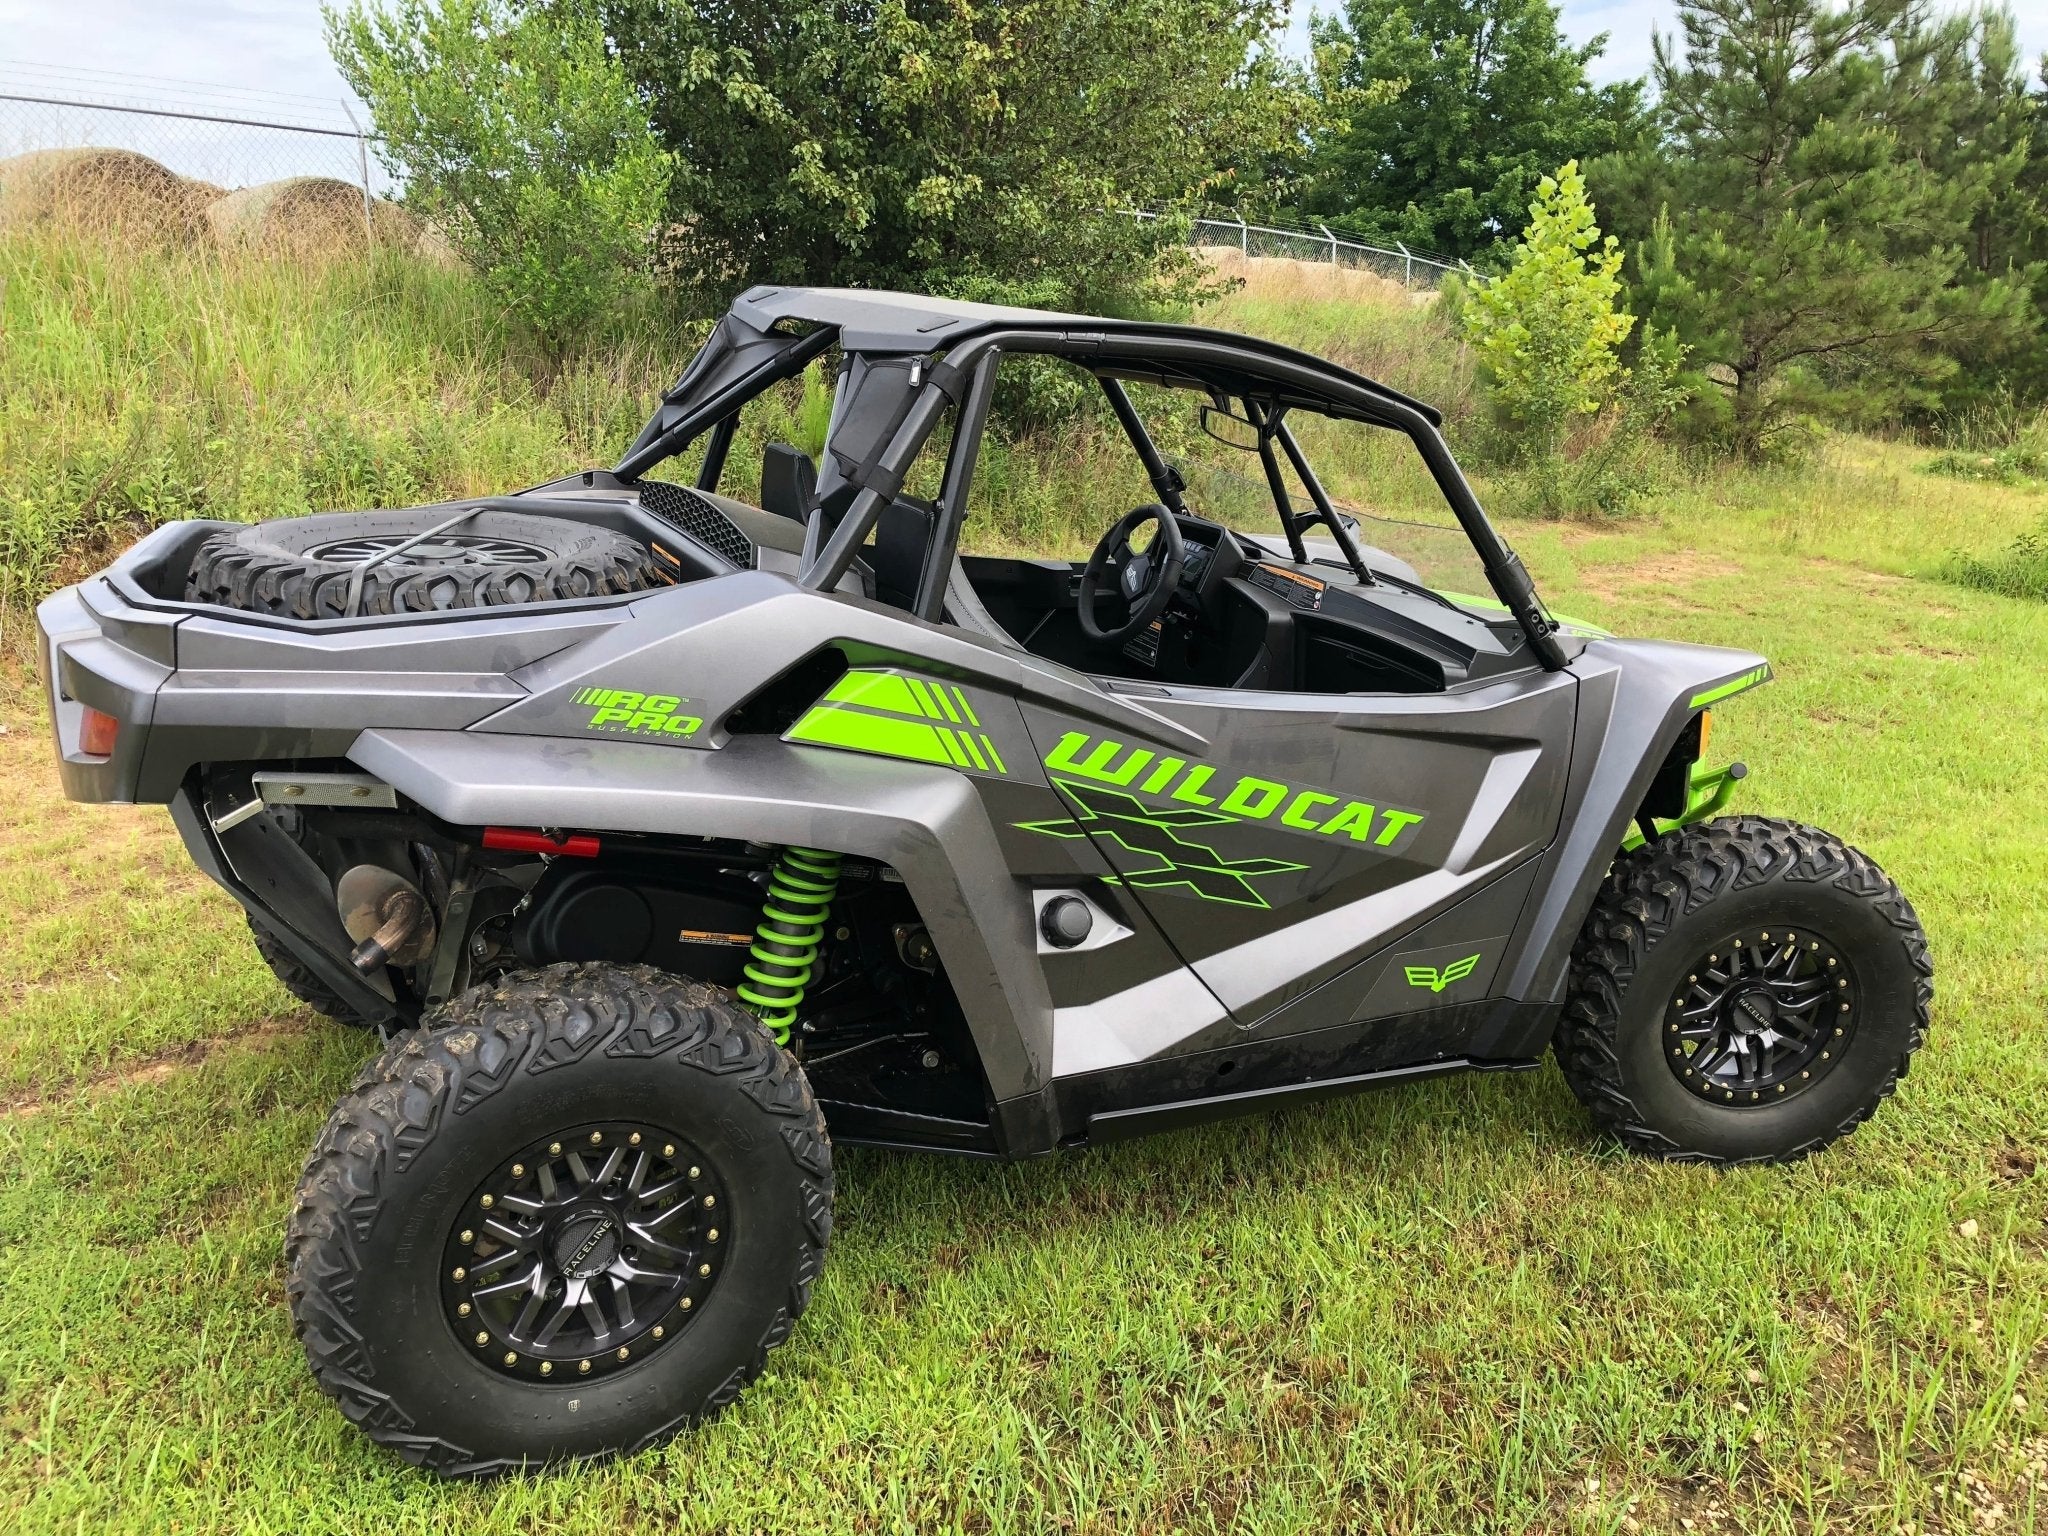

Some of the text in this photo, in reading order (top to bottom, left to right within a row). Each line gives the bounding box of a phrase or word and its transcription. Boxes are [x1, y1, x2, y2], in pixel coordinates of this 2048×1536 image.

[602, 690, 681, 714] RG
[586, 724, 692, 740] SUSPENSION
[590, 707, 703, 734] PRO
[1044, 731, 1424, 847] WILDCAT
[1739, 998, 1772, 1030] RACELINE
[562, 1219, 613, 1277] RACELINE
